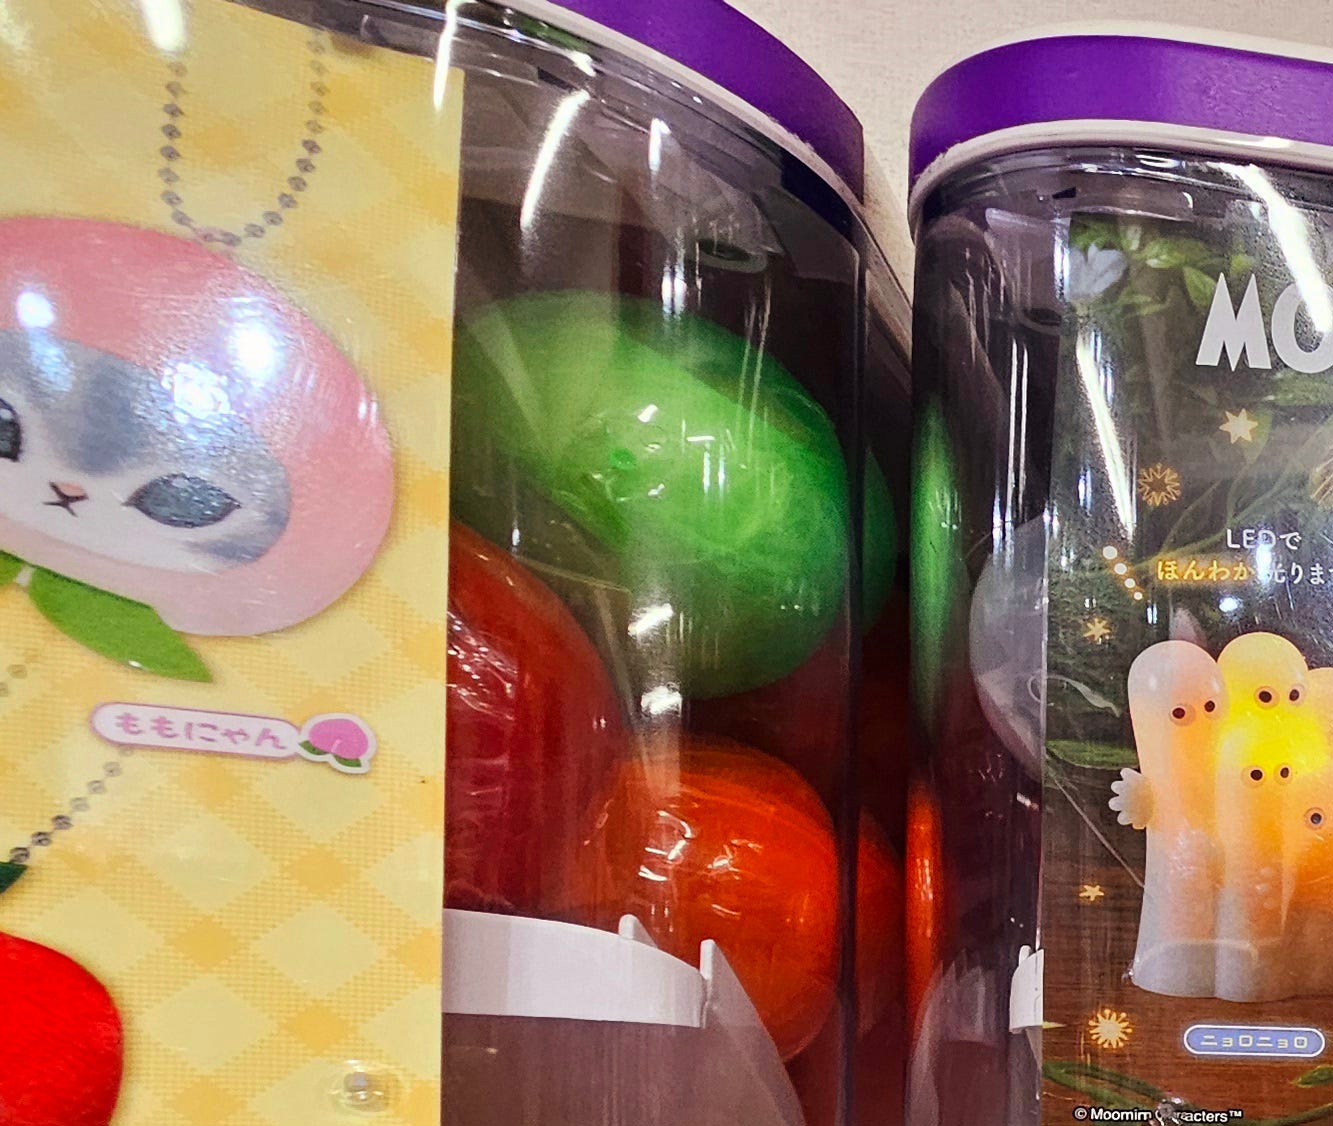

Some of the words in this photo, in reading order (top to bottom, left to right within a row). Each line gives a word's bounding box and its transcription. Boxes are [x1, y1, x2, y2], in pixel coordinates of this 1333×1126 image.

[1226, 528, 1302, 550] LEDで
[114, 711, 288, 753] ももにゃん
[1200, 1033, 1310, 1050] ニョロニョロ
